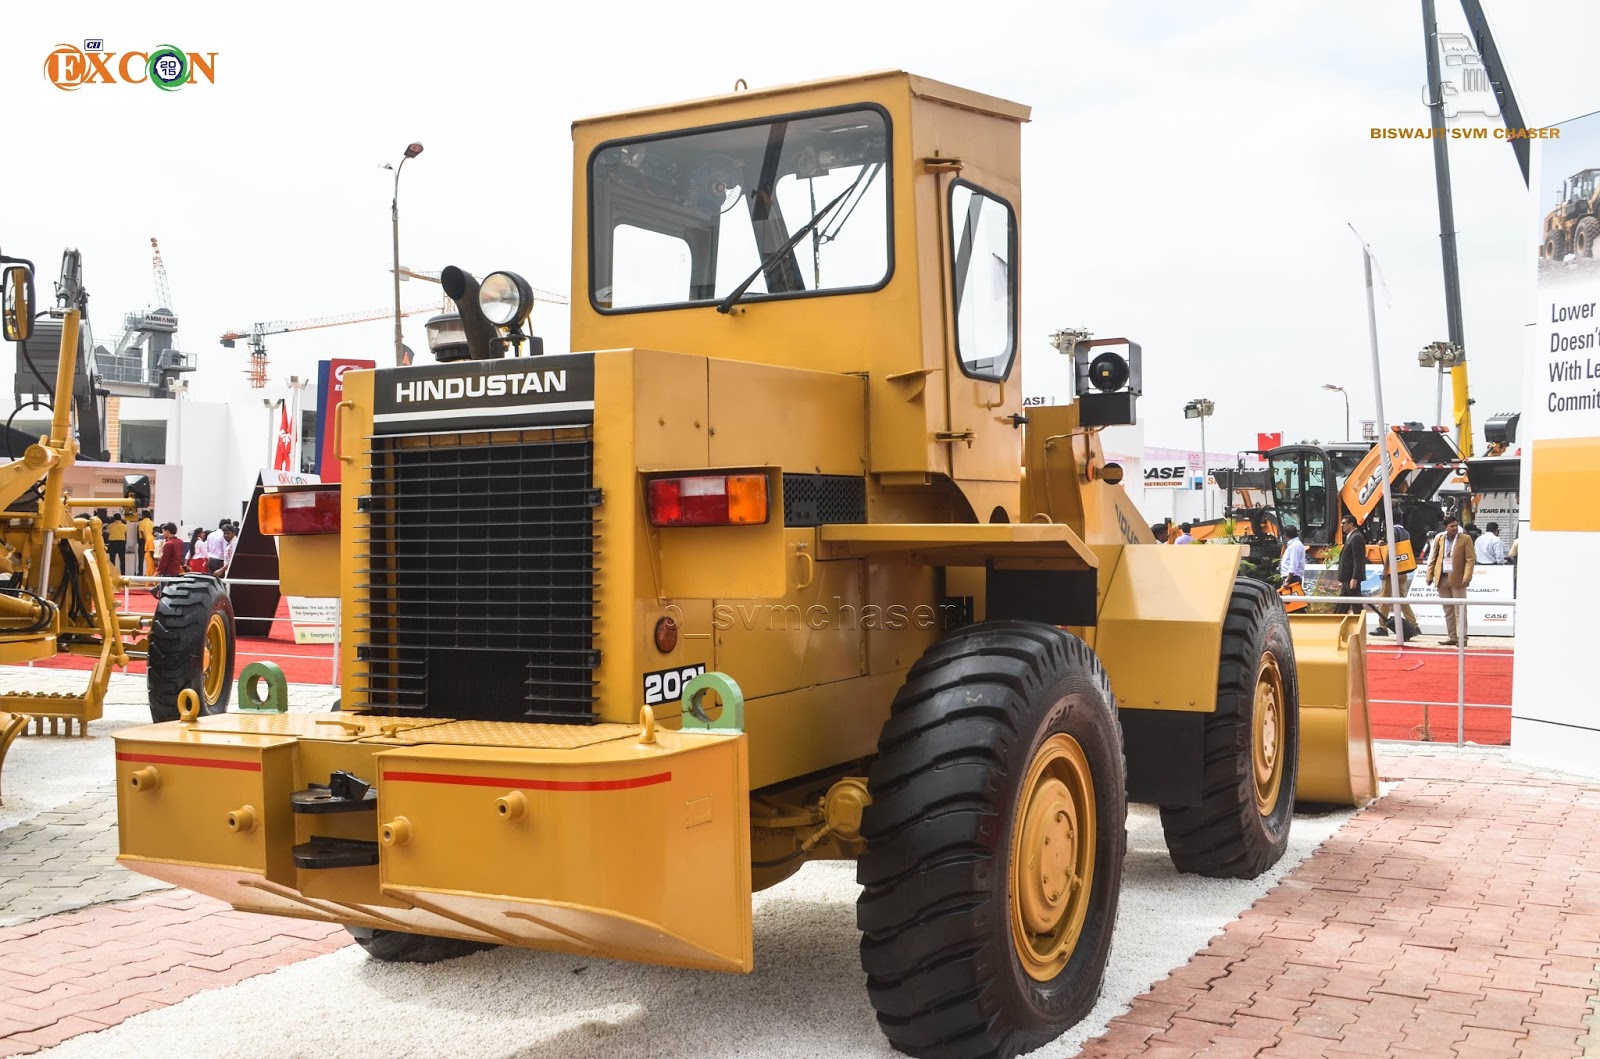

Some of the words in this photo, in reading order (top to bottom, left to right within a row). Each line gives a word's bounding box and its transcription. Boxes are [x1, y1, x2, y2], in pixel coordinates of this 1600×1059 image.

[145, 315, 175, 324] AMMANN
[1552, 303, 1596, 323] Lower
[1549, 359, 1582, 382] With
[396, 370, 567, 403] HINDUSTAN
